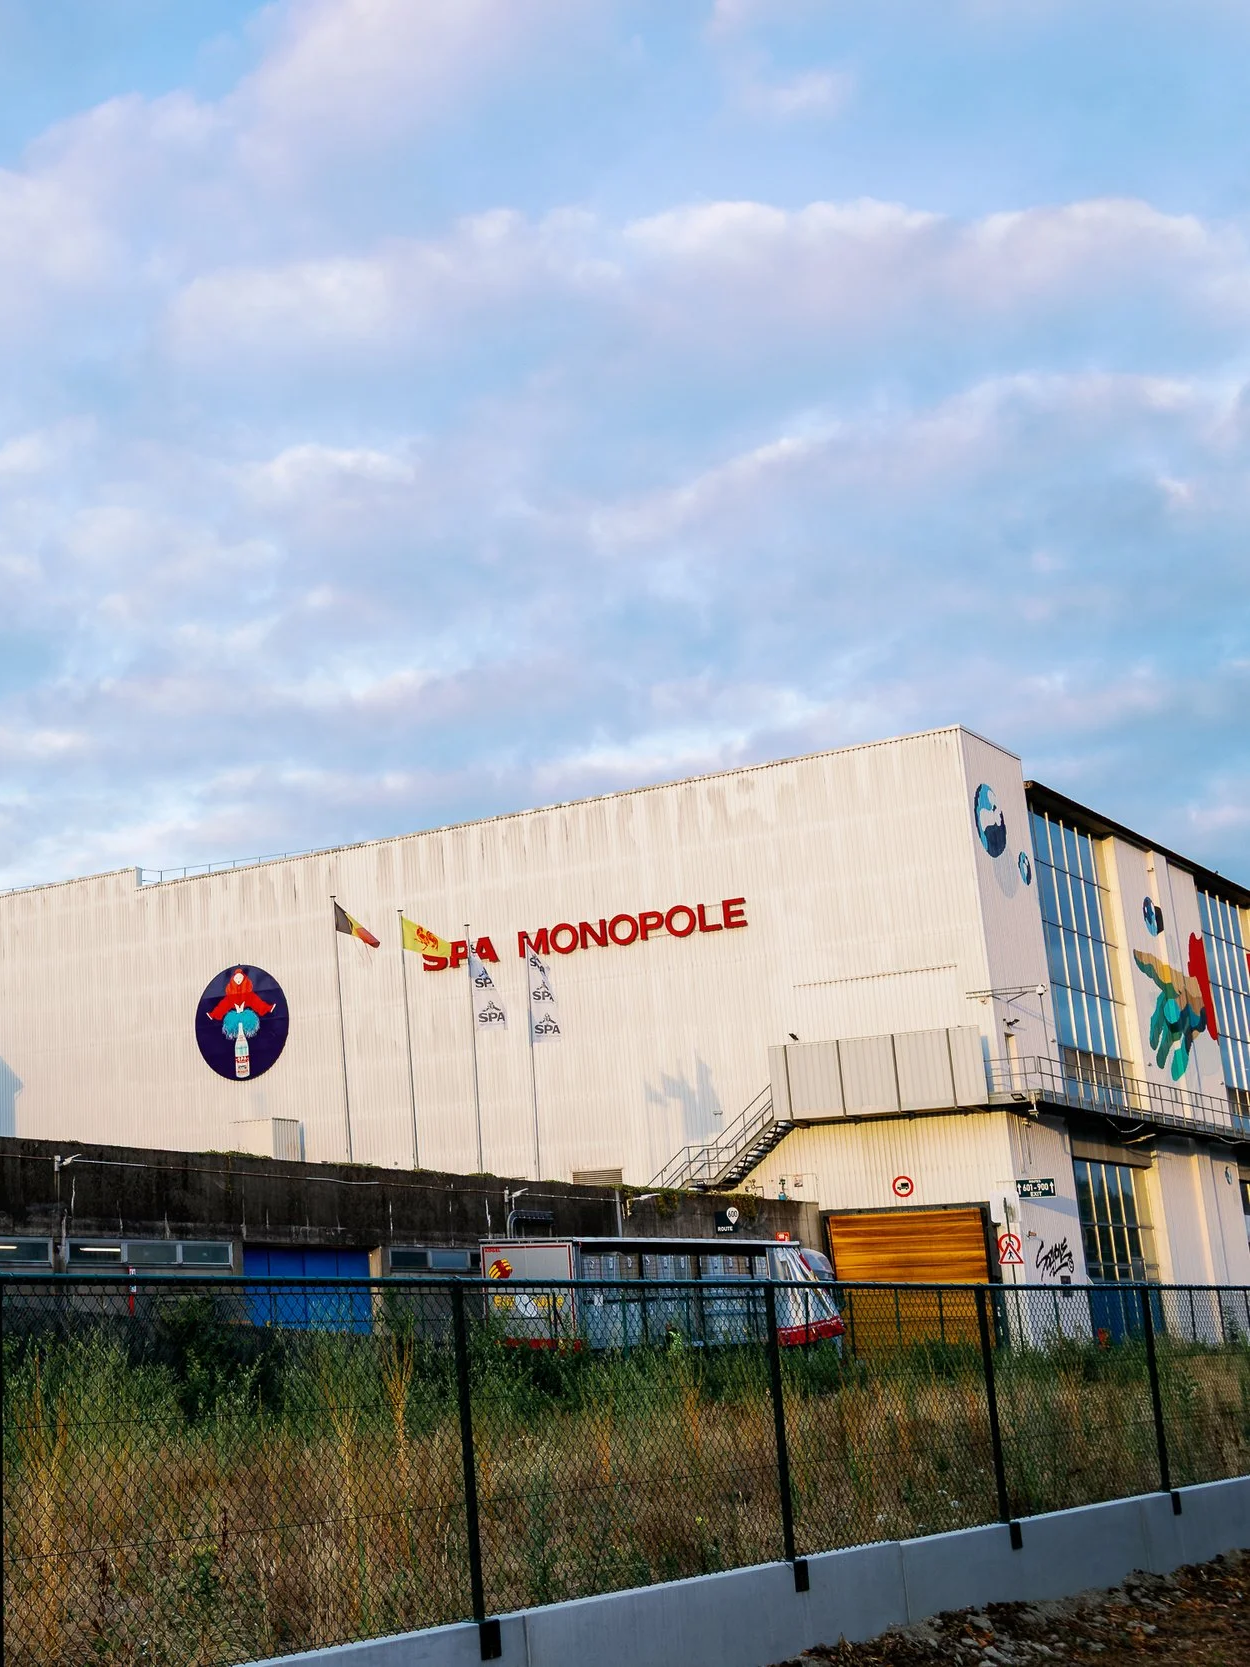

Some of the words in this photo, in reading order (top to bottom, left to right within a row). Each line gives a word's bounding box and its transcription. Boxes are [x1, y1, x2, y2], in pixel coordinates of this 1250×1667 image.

[422, 936, 500, 971] SPA
[517, 897, 748, 959] MONOPOLE
[475, 978, 495, 988] SP
[478, 1012, 506, 1022] SPA
[534, 1024, 561, 1034] SPA
